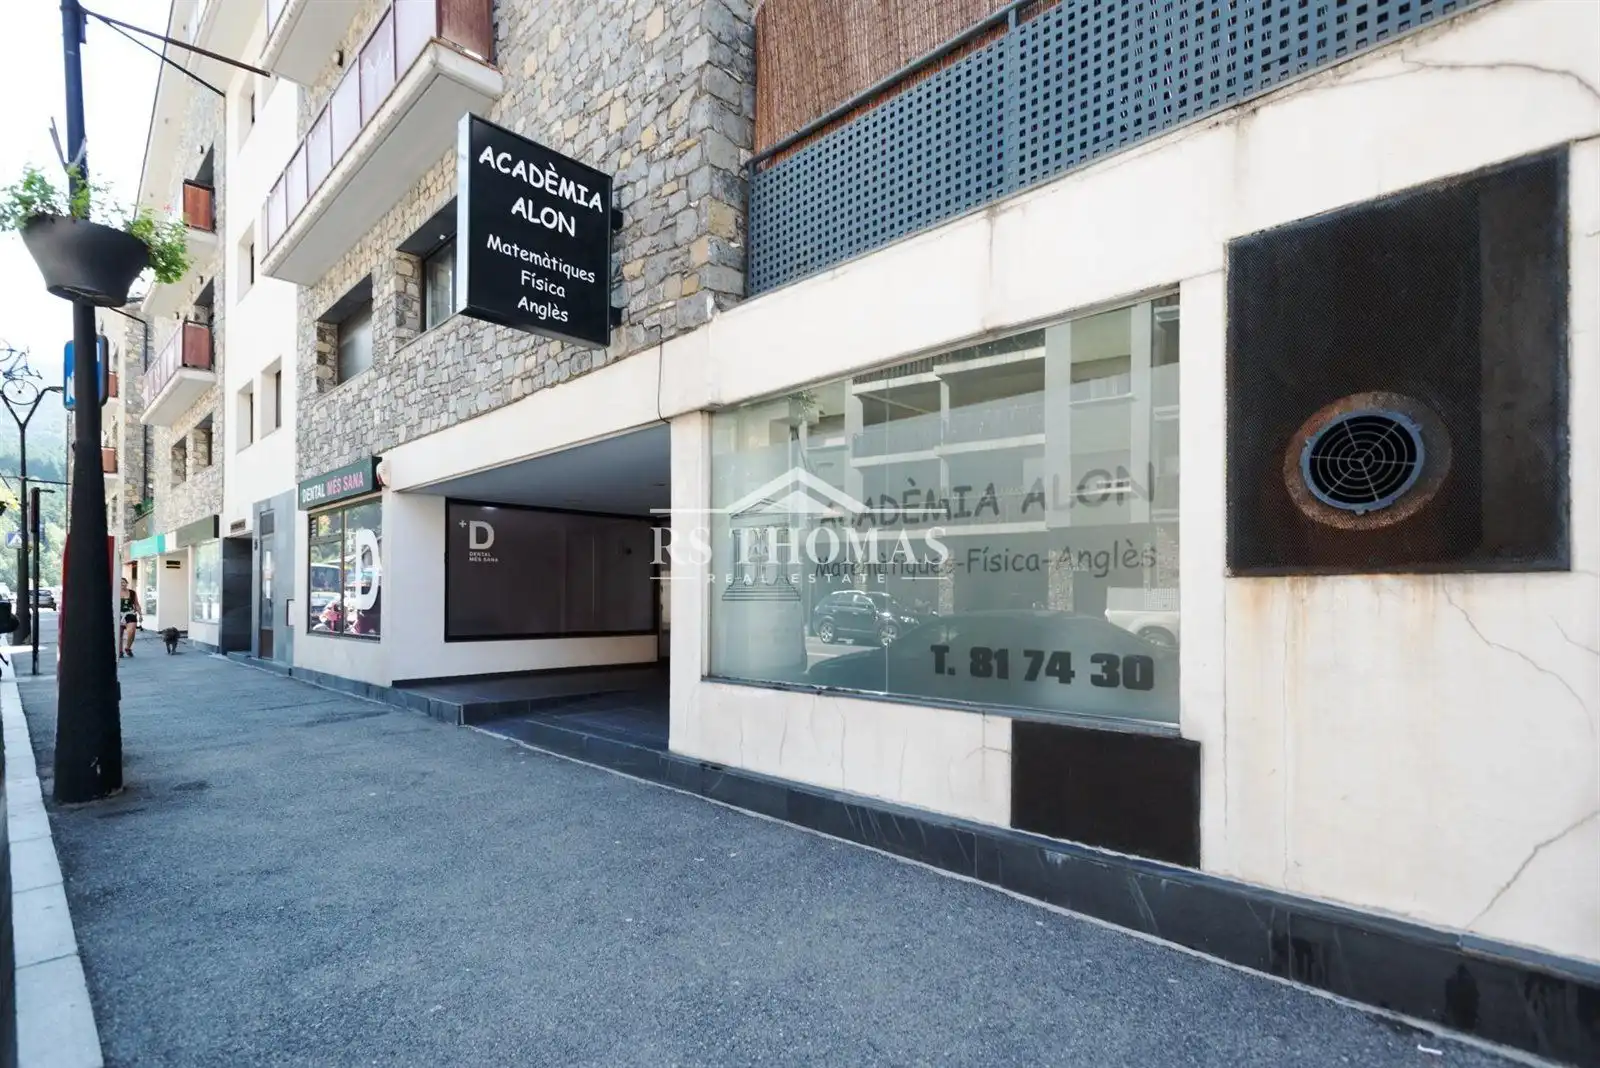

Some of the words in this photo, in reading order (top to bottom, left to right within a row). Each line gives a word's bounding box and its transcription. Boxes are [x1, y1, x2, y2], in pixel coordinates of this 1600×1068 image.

[478, 145, 604, 213] ACADÈMIA
[511, 196, 576, 237] ALON
[487, 233, 596, 283] Matemàtiques
[521, 269, 566, 298] Física
[517, 296, 569, 322] Anglès
[302, 483, 326, 503] DENTAL
[343, 471, 364, 491] SANA
[1021, 461, 1155, 515] ALON
[930, 645, 956, 676] T.
[969, 646, 1009, 680] 81
[1023, 649, 1076, 684] 74
[1090, 653, 1155, 691] 30
